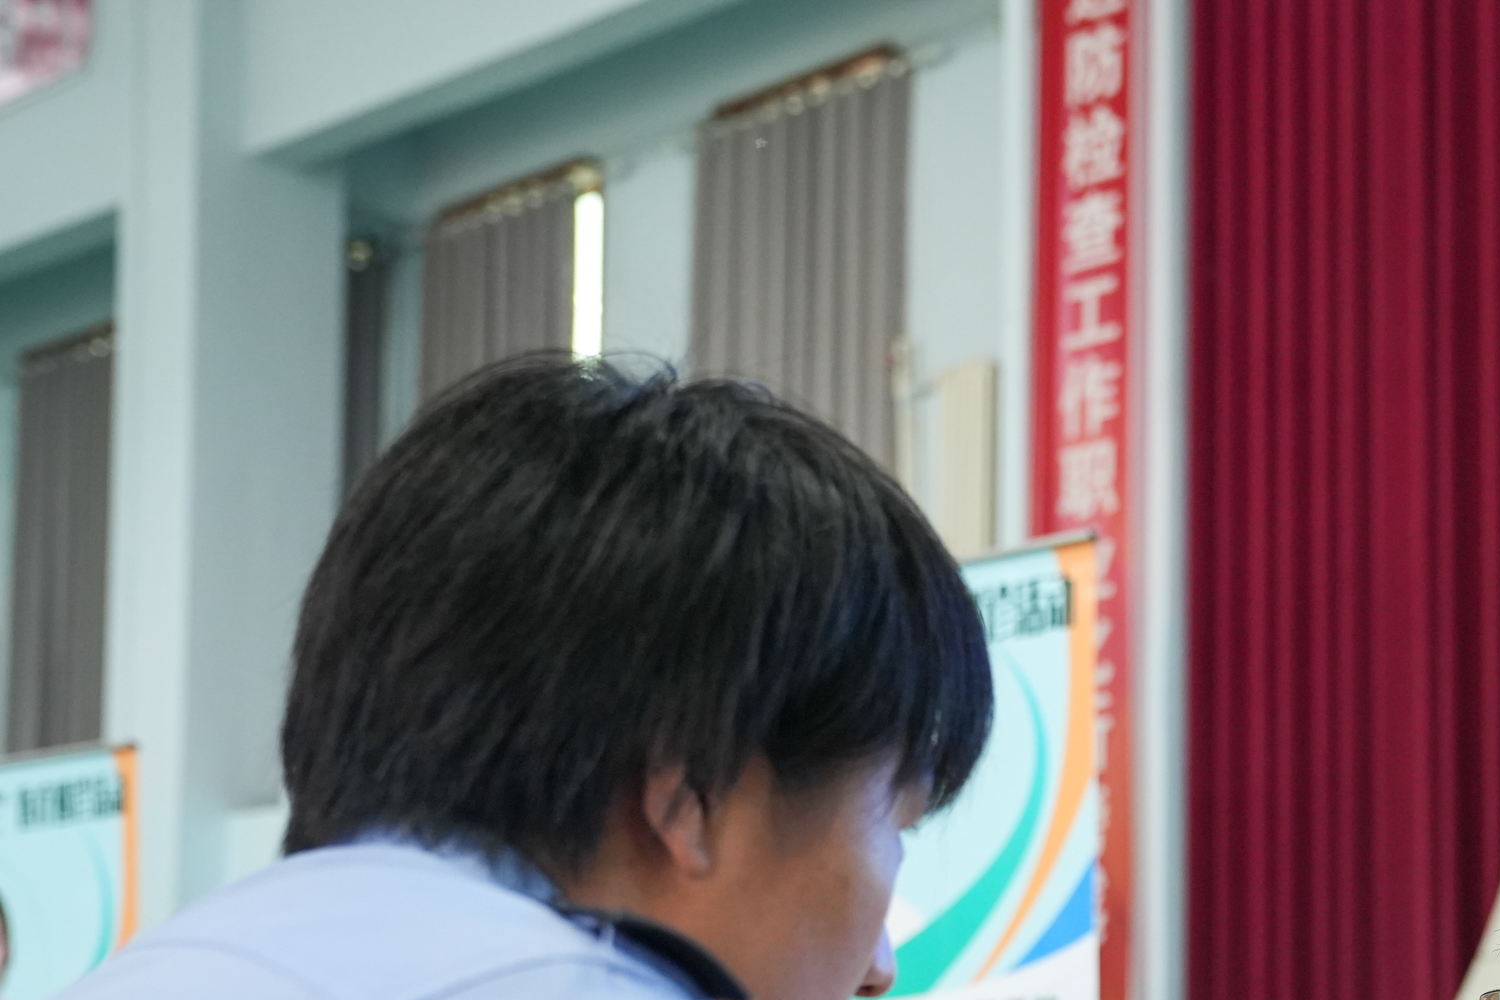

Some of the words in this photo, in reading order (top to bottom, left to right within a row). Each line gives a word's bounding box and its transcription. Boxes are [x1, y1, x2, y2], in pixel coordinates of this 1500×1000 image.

[1057, 0, 1124, 522] 防检查工作职
